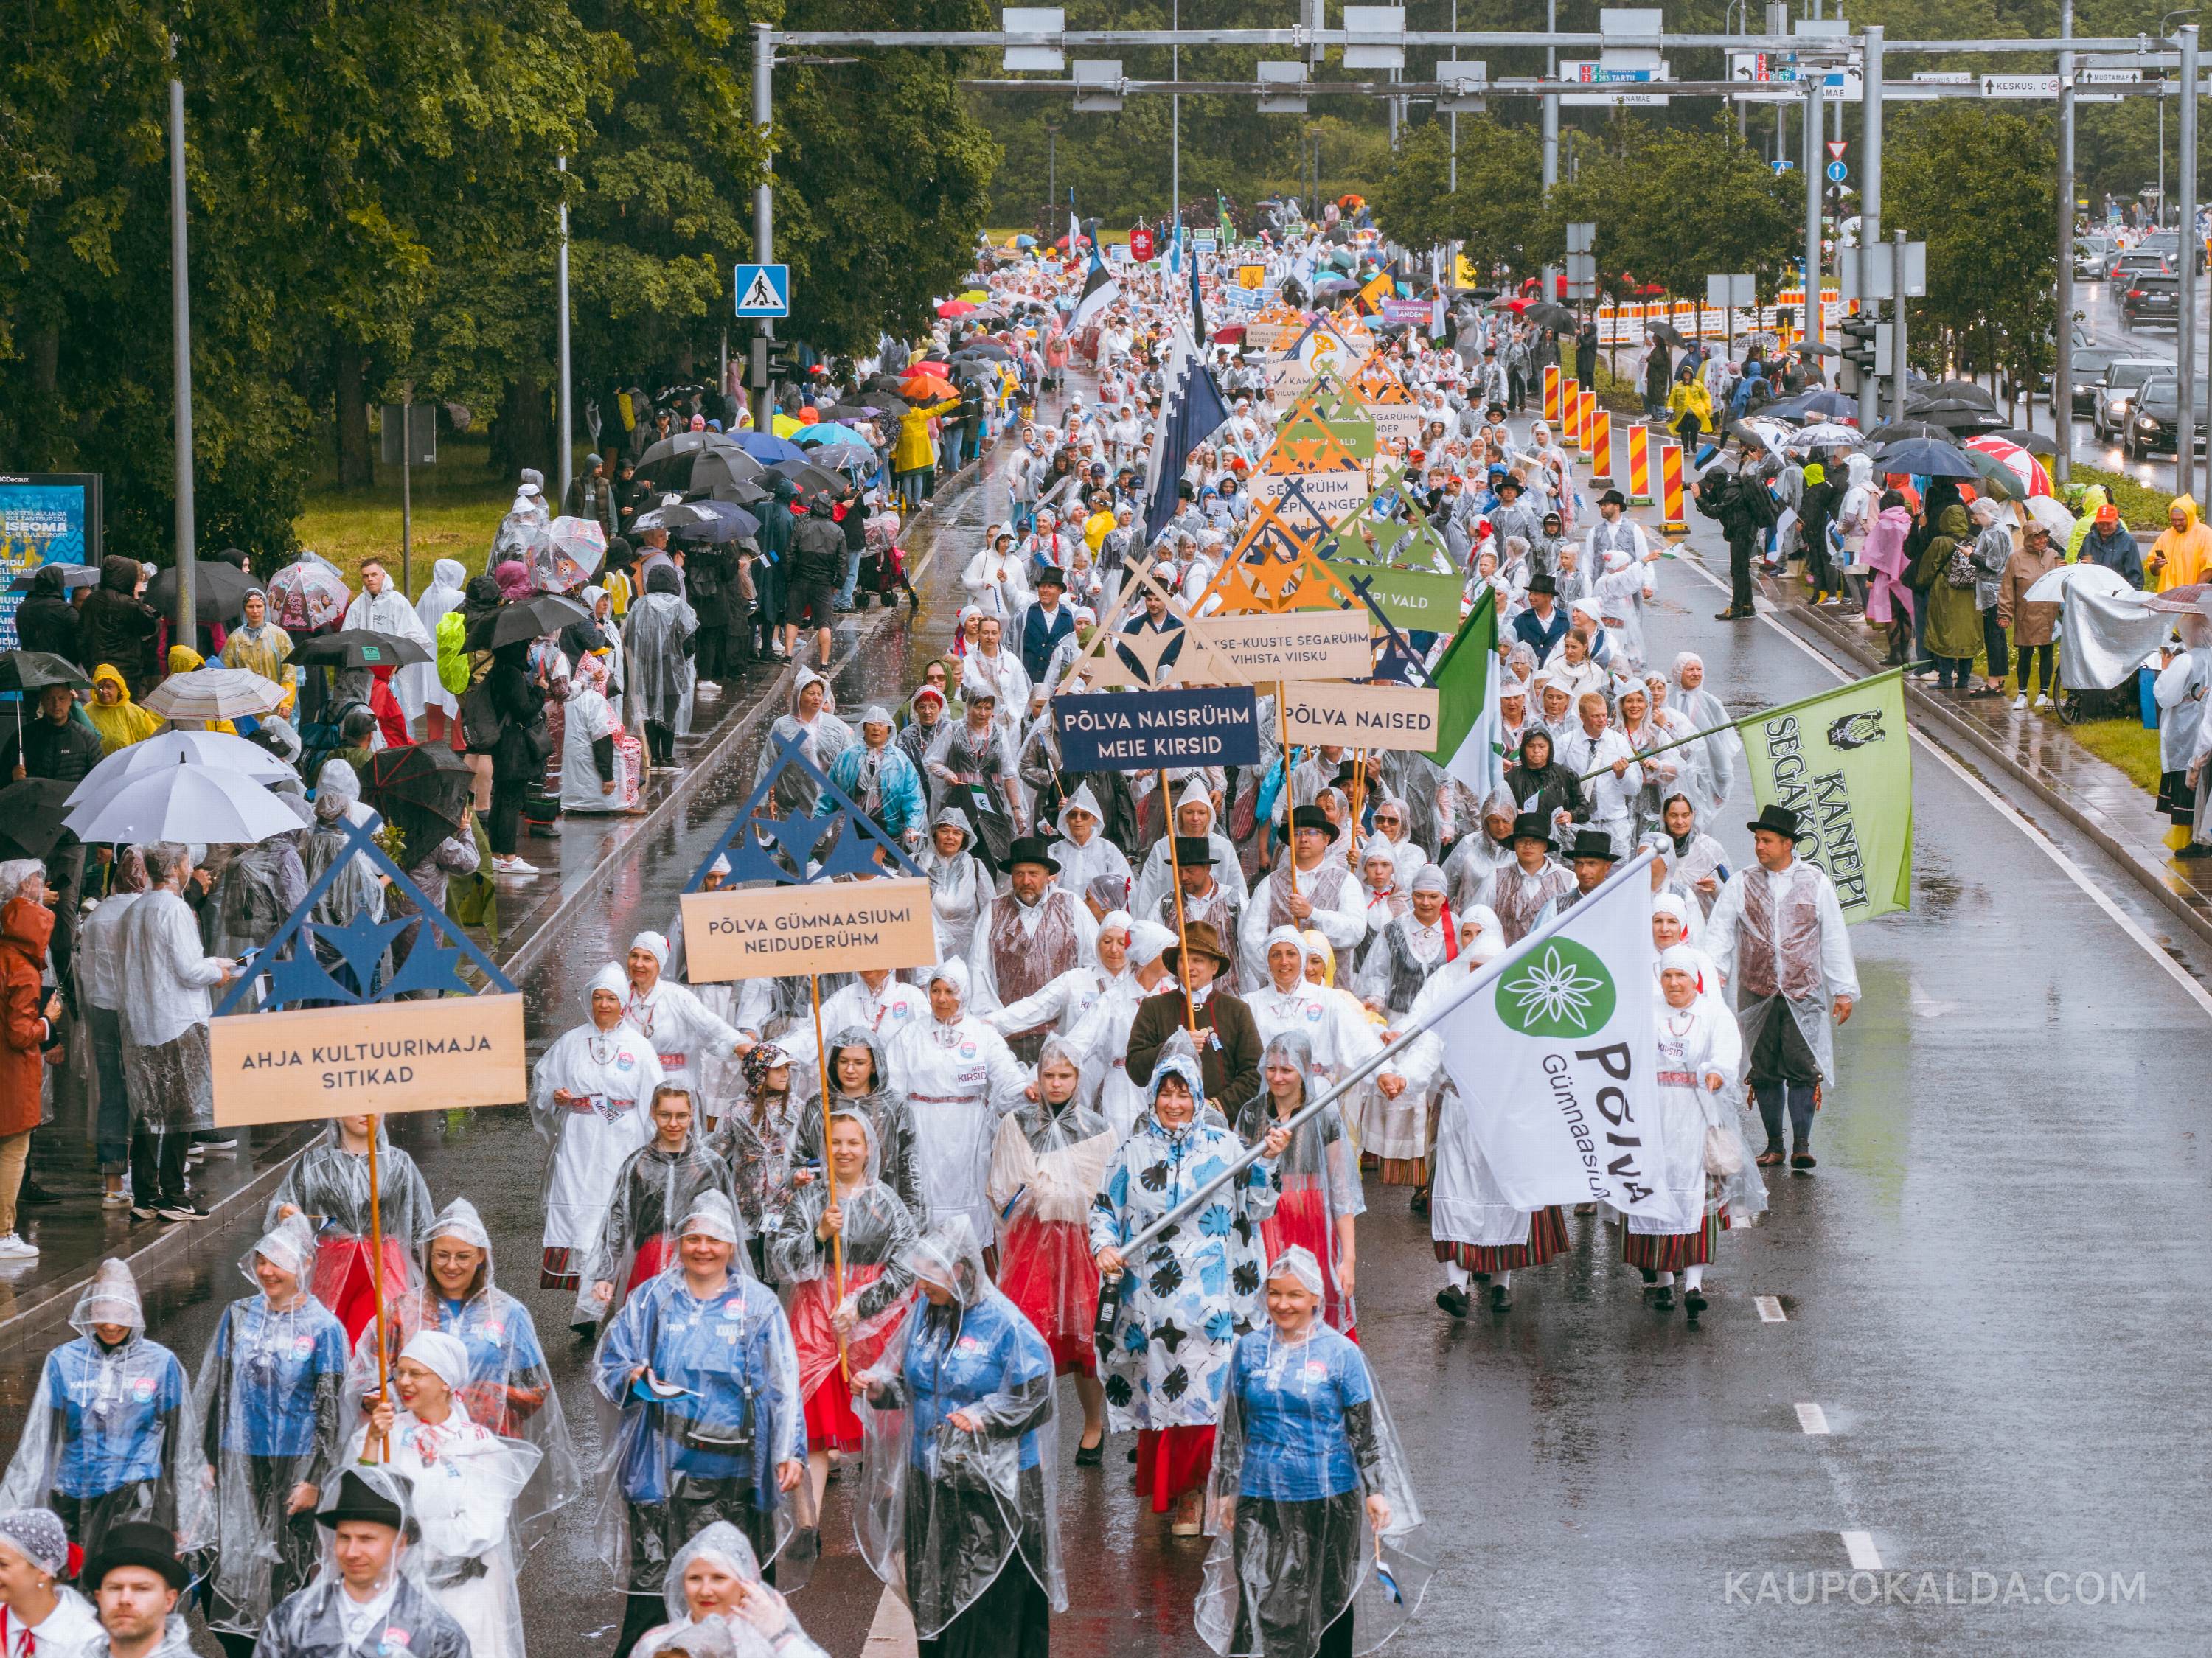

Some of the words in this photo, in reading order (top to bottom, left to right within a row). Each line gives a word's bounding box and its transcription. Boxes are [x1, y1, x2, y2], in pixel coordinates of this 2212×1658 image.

[1795, 88, 1844, 97] LAMÄE
[1997, 82, 2036, 91] KESKUS,
[2041, 82, 2047, 90] C
[1250, 501, 1302, 515] KEPI
[5, 522, 68, 532] ISEOMA
[1333, 587, 1386, 605] KEPI
[1391, 593, 1428, 609] VALD
[1194, 635, 1293, 652] ATSE-KUUSTE
[1297, 631, 1368, 647] SEGARÜHM
[1231, 653, 1281, 665] VIHISTA
[1285, 651, 1328, 662] VIISKU
[1064, 708, 1133, 732] PÕLVA
[1138, 704, 1251, 729] NAISRÜHM
[1285, 703, 1348, 726] PÕLVA
[1356, 711, 1432, 731] NAISED
[1097, 739, 1147, 759] MEIE
[1154, 735, 1222, 756] KIRSID
[1761, 714, 1829, 875] SEGAKO
[1812, 768, 1871, 913] KANEPI
[709, 916, 768, 936] PÕLVA
[775, 908, 911, 932] GÜMNAASIUMI
[744, 930, 880, 955] NEIDUDERÜHM
[241, 1050, 303, 1070] AHJA
[312, 1034, 493, 1064] KULTUURIMAJA
[321, 1066, 414, 1089] SITIKAD
[957, 1071, 988, 1083] KIRSID
